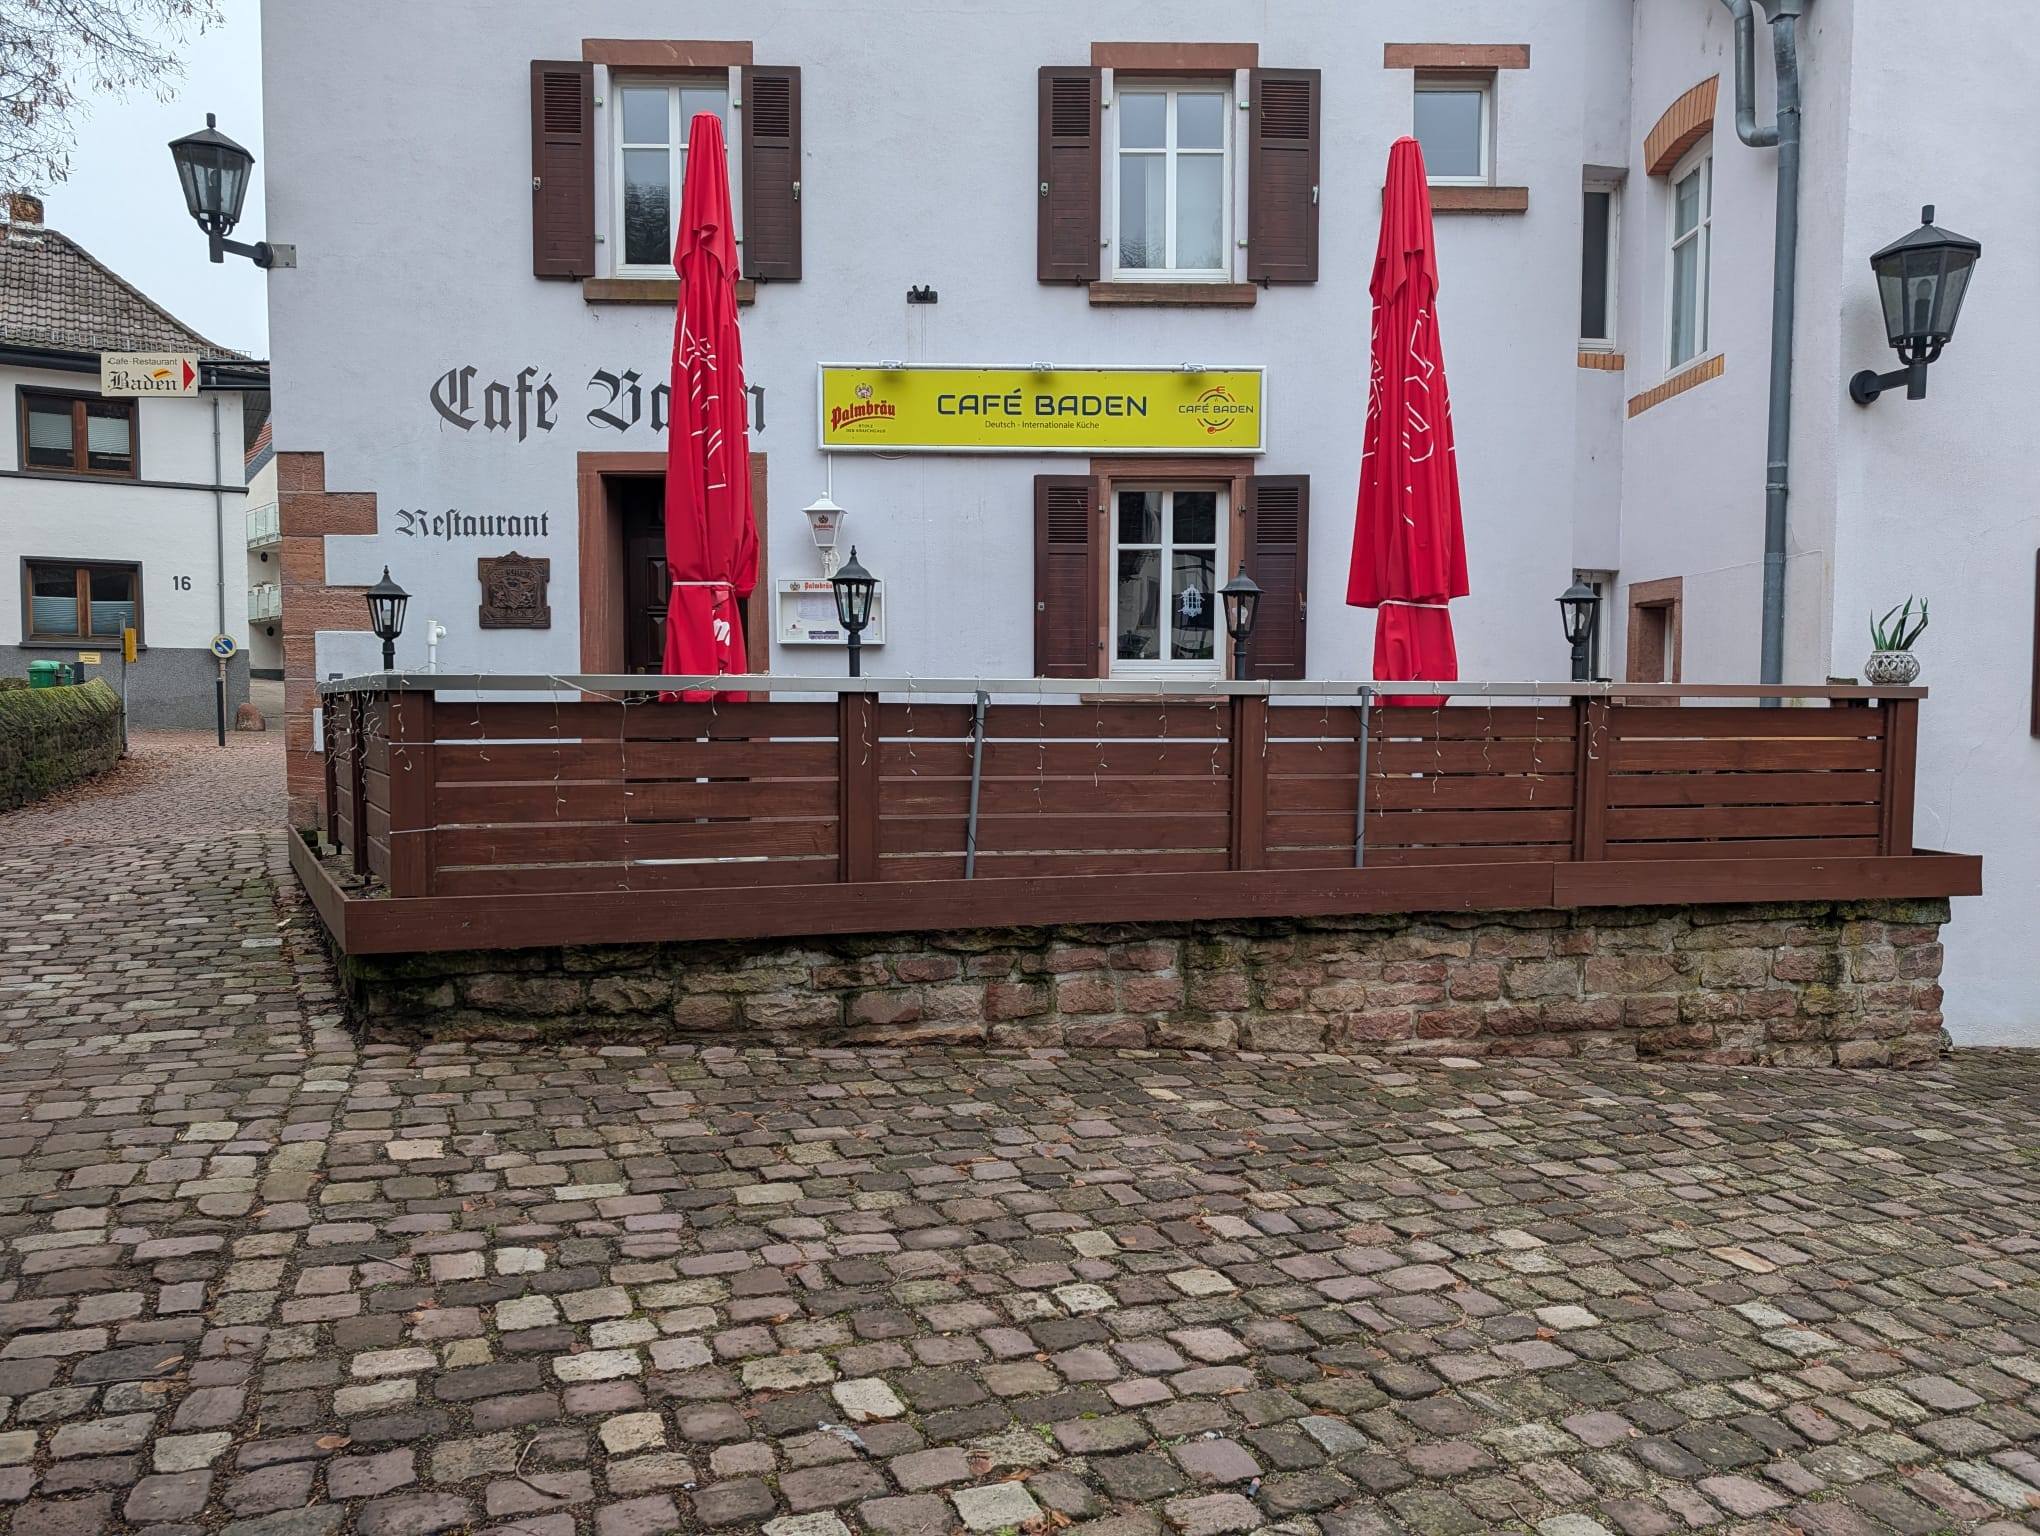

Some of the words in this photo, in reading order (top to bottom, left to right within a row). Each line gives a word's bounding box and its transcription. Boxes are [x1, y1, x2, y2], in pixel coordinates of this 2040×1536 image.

[109, 371, 177, 391] Baden
[430, 365, 559, 443] Café
[587, 366, 766, 435] Ban
[938, 388, 1022, 416] CAFÉ
[1035, 395, 1147, 417] BADEN
[1178, 403, 1210, 413] CAFÉ
[1213, 405, 1254, 413] BADEN
[831, 400, 896, 432] Palmbräu
[985, 420, 1016, 429] Deutsch
[1022, 420, 1075, 429] Internationale
[1076, 420, 1100, 430] Küche
[173, 576, 191, 591] 16
